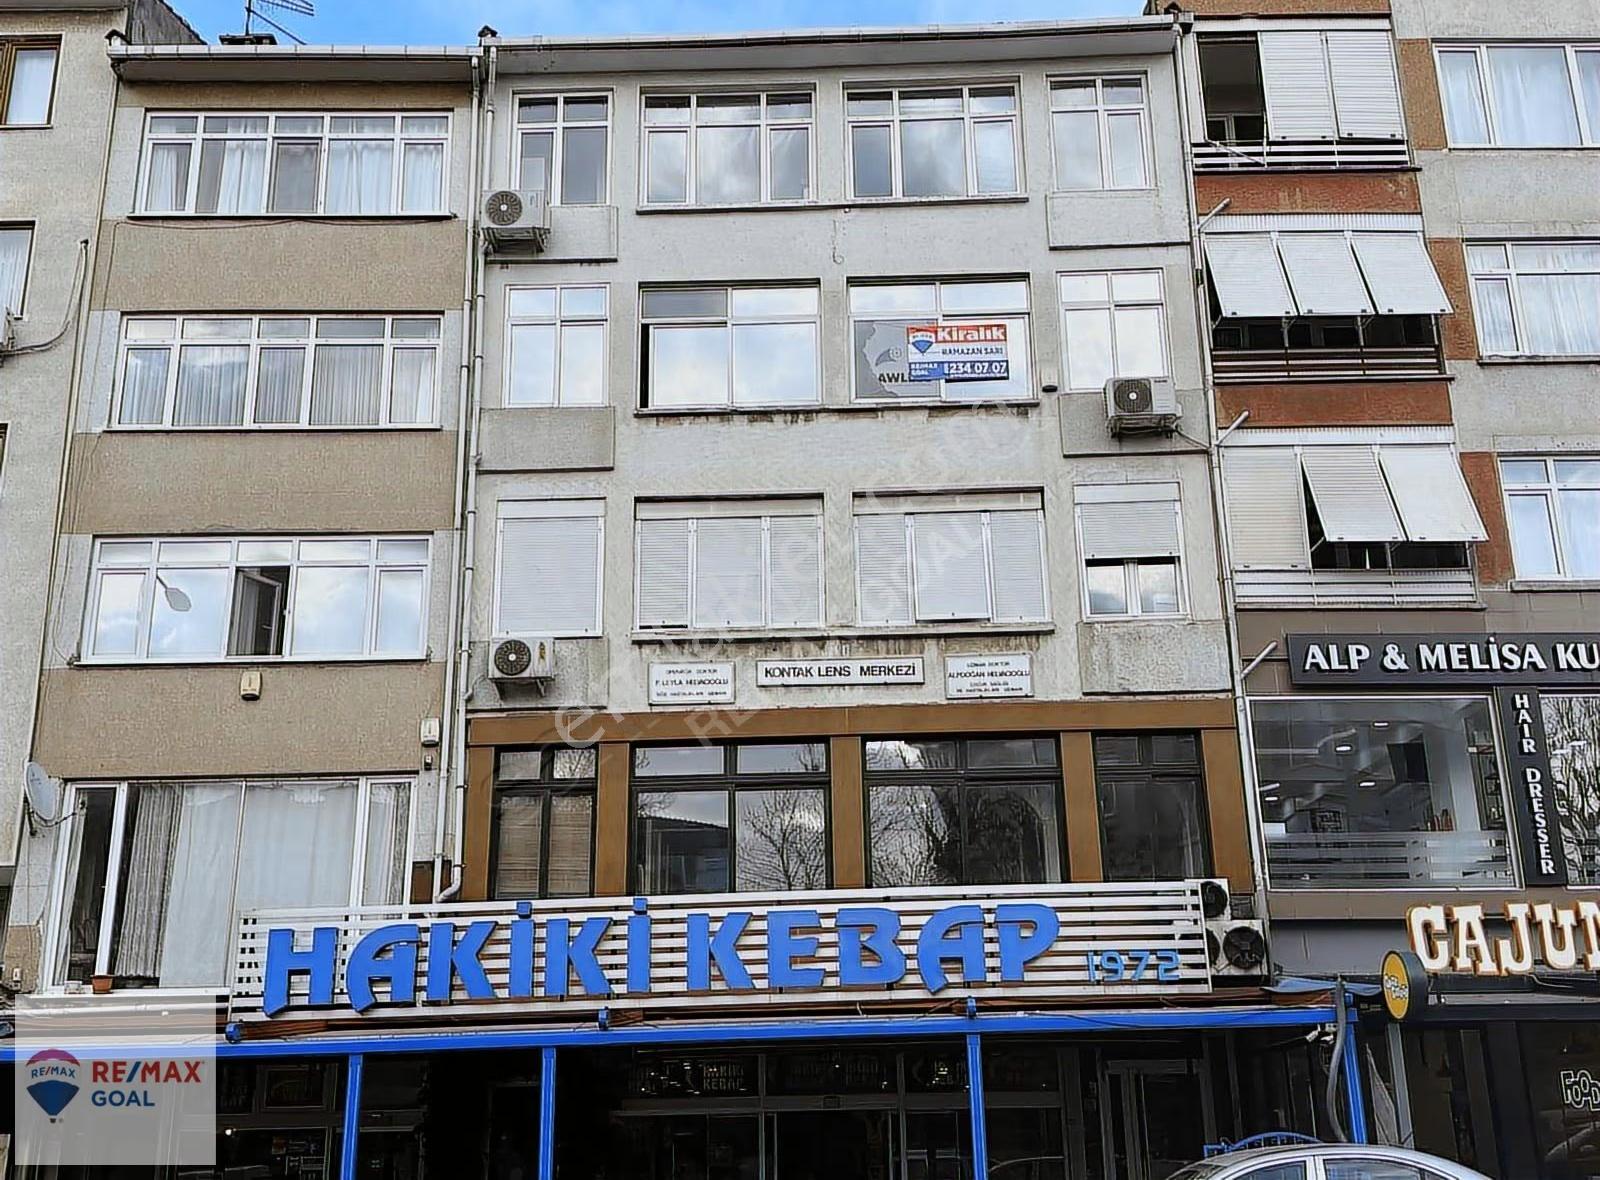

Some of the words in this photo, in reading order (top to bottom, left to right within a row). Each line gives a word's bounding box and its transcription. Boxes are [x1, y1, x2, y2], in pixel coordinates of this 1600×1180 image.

[765, 666, 813, 678] KONTAK
[818, 665, 851, 677] LENS
[860, 663, 916, 676] MERKEZİ
[1304, 643, 1370, 670] ALP
[1383, 643, 1409, 670] &
[1419, 636, 1547, 670] MELİSA
[1514, 694, 1537, 753] HAIR
[1525, 767, 1555, 875] DRESSER
[262, 897, 652, 1018] HAKİKİ
[686, 903, 1060, 994] KEBAP
[1086, 950, 1182, 983] 1972
